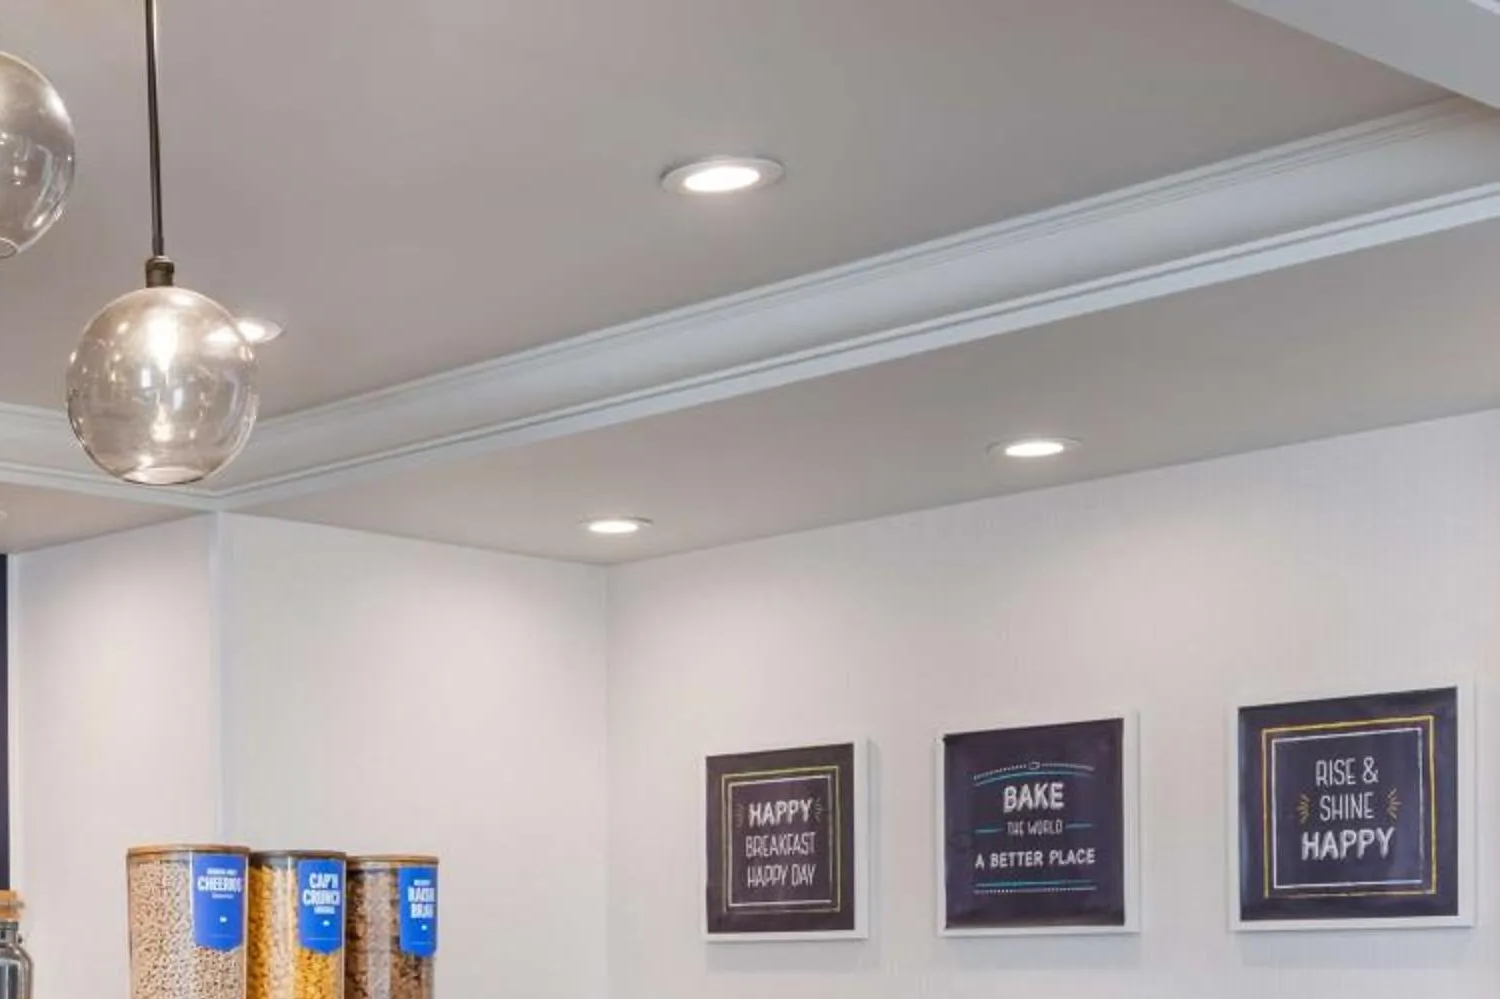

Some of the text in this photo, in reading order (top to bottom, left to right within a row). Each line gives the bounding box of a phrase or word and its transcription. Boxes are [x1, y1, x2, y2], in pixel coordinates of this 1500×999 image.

[1315, 756, 1379, 787] RISE &
[1003, 781, 1065, 813] BAKE
[1319, 791, 1375, 822] SHINE
[748, 797, 814, 829] HAPPY
[1027, 818, 1063, 836] WORLD
[745, 831, 817, 859] BREAKFAST
[975, 847, 1097, 869] A BETTER PLACE
[1301, 826, 1395, 861] HAPPY
[747, 863, 817, 889] HAPPY DAY
